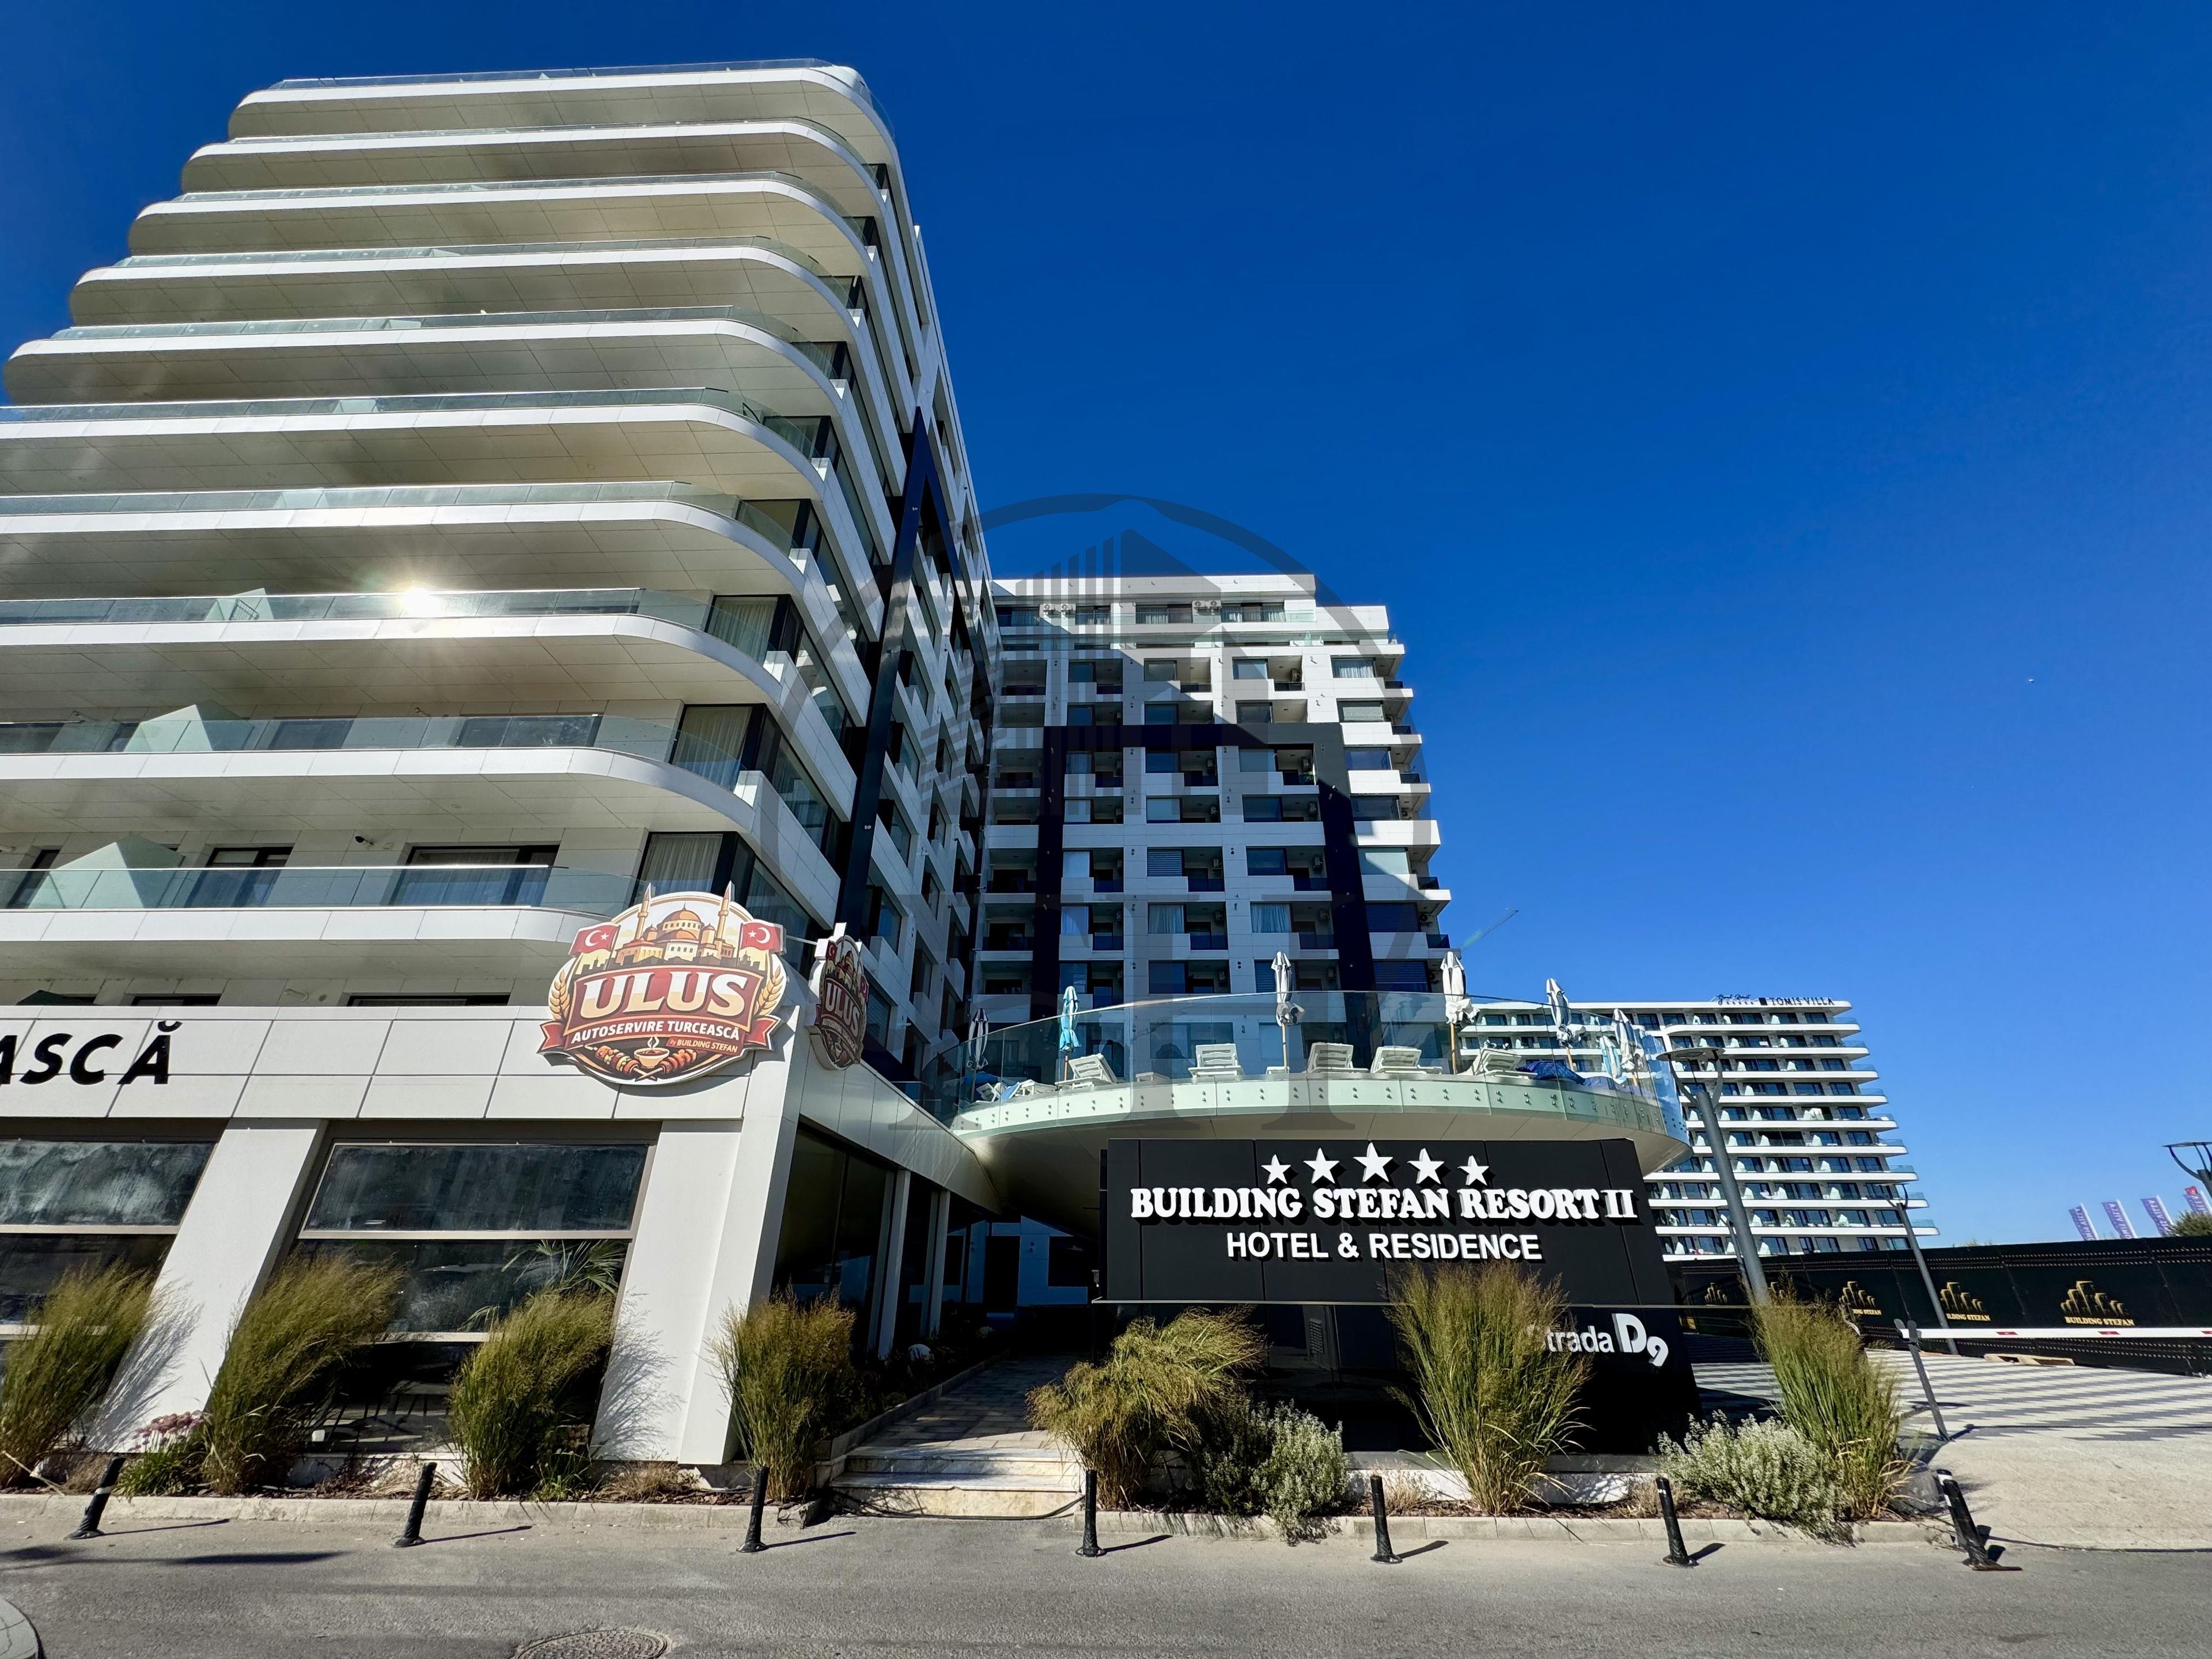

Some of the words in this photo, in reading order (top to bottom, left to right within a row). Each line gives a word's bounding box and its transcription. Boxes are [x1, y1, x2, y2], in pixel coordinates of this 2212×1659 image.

[580, 971, 748, 1018] ULUS
[1769, 997, 1802, 1006] TOMIS
[1803, 997, 1835, 1006] VILLA
[825, 982, 861, 1037] ULUS
[571, 1021, 664, 1044] AUTOSERVIRE
[667, 1021, 739, 1040] TURCEASCĂ
[676, 1039, 710, 1048] BUILDING
[711, 1043, 738, 1053] STEFAN
[1130, 1188, 1303, 1218] BUILDING
[1313, 1188, 1450, 1219] STEFAN
[1457, 1188, 1600, 1219] RESORT
[1604, 1190, 1638, 1218] II
[1227, 1232, 1329, 1258] HOTEL
[1338, 1232, 1360, 1258] &
[1369, 1233, 1543, 1260] RESIDENCE
[2064, 1316, 2103, 1325] BUILDING
[2103, 1318, 2135, 1326] STEFAN
[1532, 1324, 1615, 1353] trada
[1611, 1313, 1669, 1367] D9
